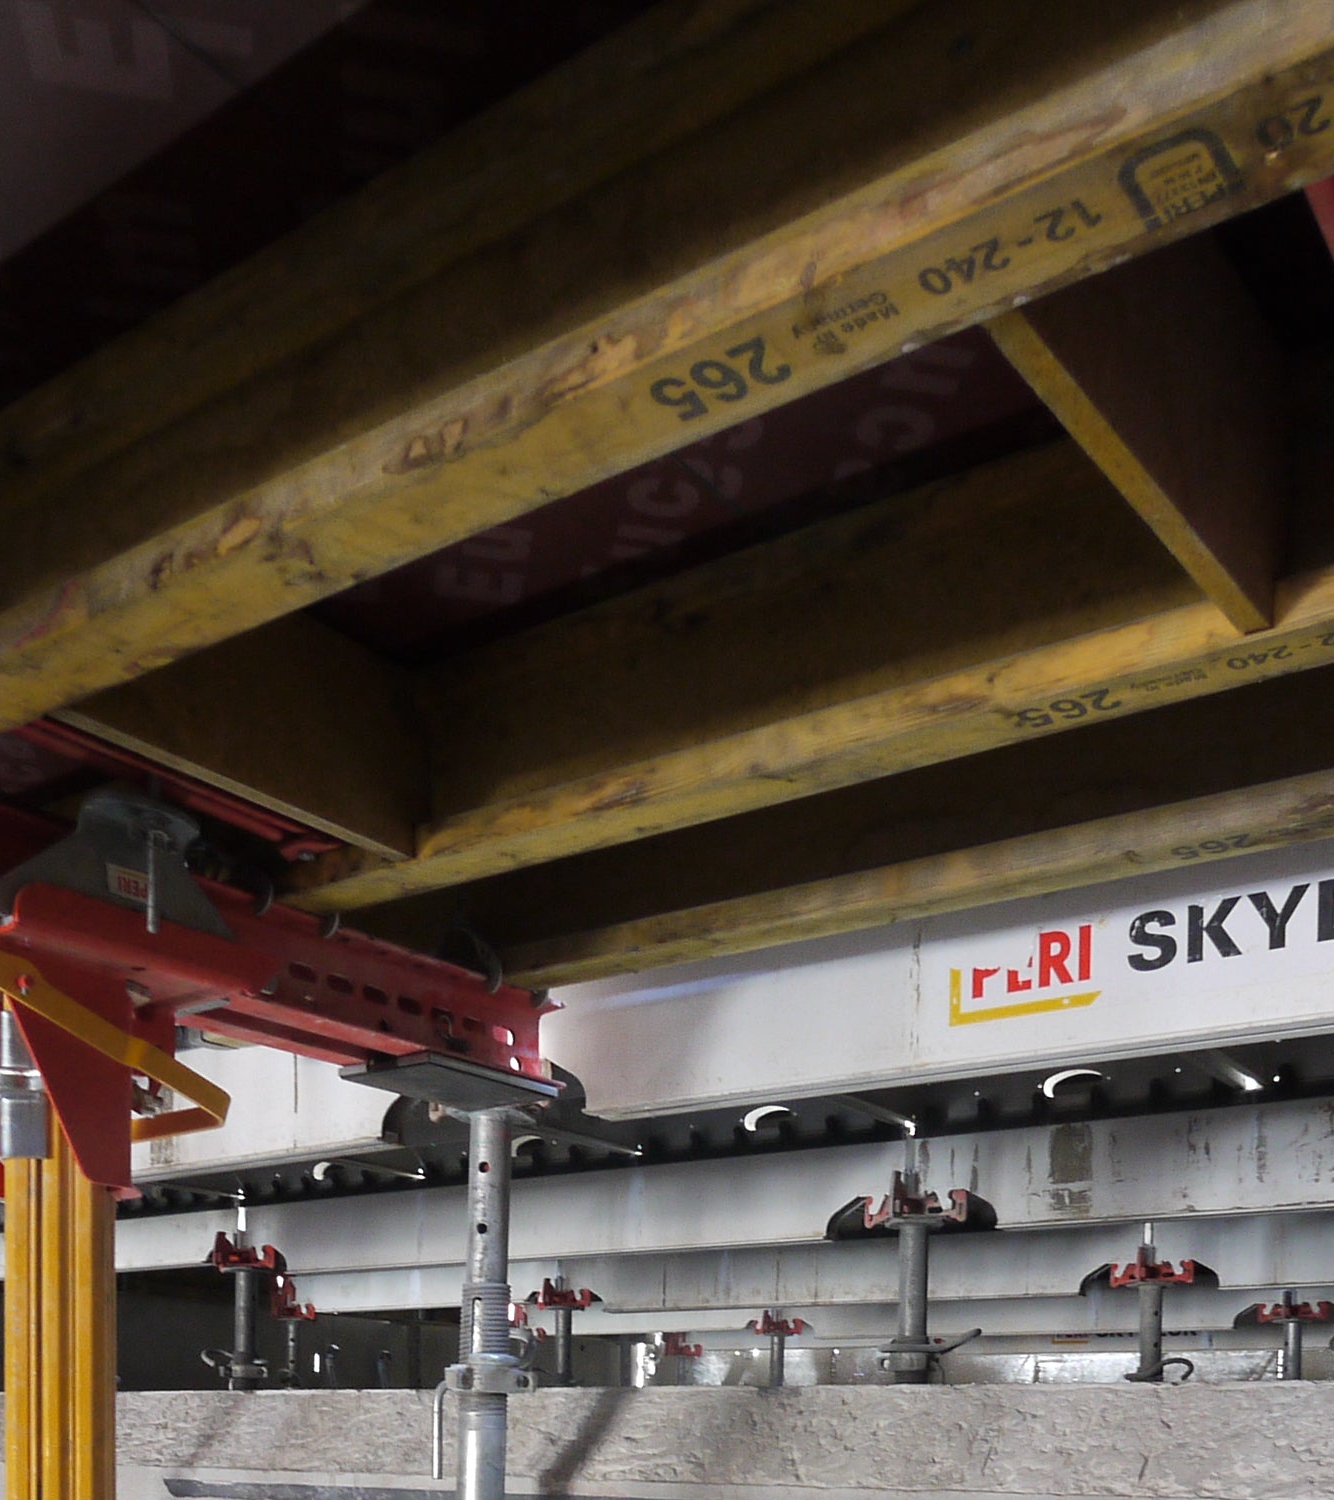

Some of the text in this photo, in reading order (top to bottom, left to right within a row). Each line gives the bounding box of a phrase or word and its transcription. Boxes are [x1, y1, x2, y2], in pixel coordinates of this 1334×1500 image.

[919, 203, 1103, 295] 12-240
[650, 336, 792, 421] 265
[1013, 688, 1122, 730] 265
[1170, 834, 1251, 862] 265
